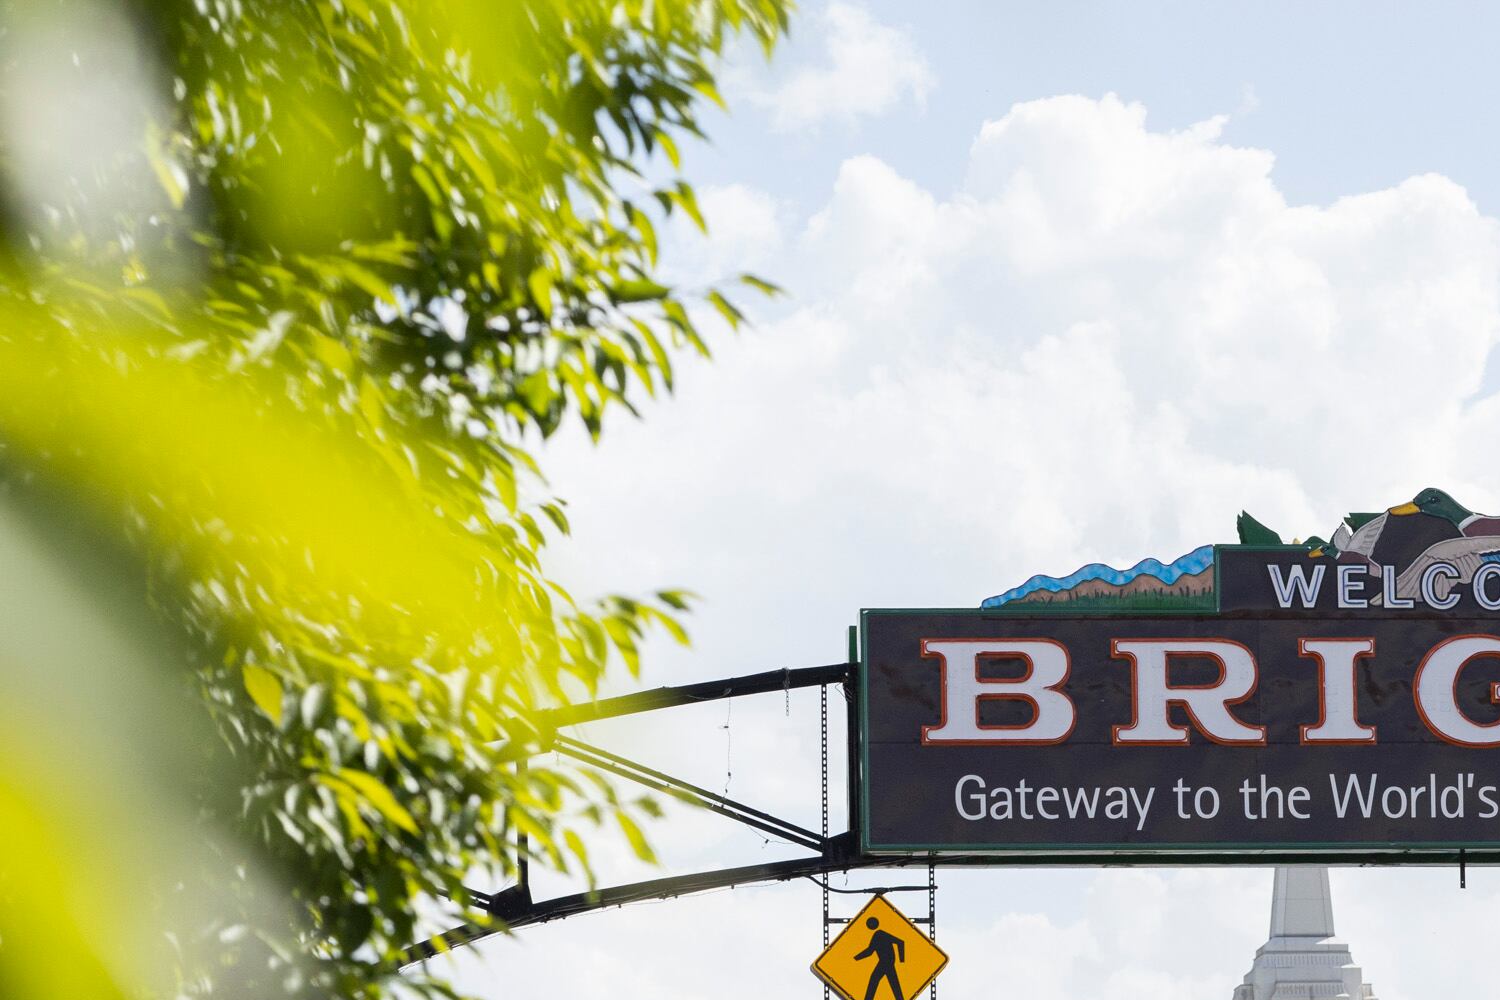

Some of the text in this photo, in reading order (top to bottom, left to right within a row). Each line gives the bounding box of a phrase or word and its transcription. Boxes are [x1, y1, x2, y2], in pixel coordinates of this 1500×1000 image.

[954, 773, 1155, 831] Gateway
[1172, 777, 1220, 820] to
[1240, 774, 1311, 820] the
[1329, 772, 1499, 819] World's
